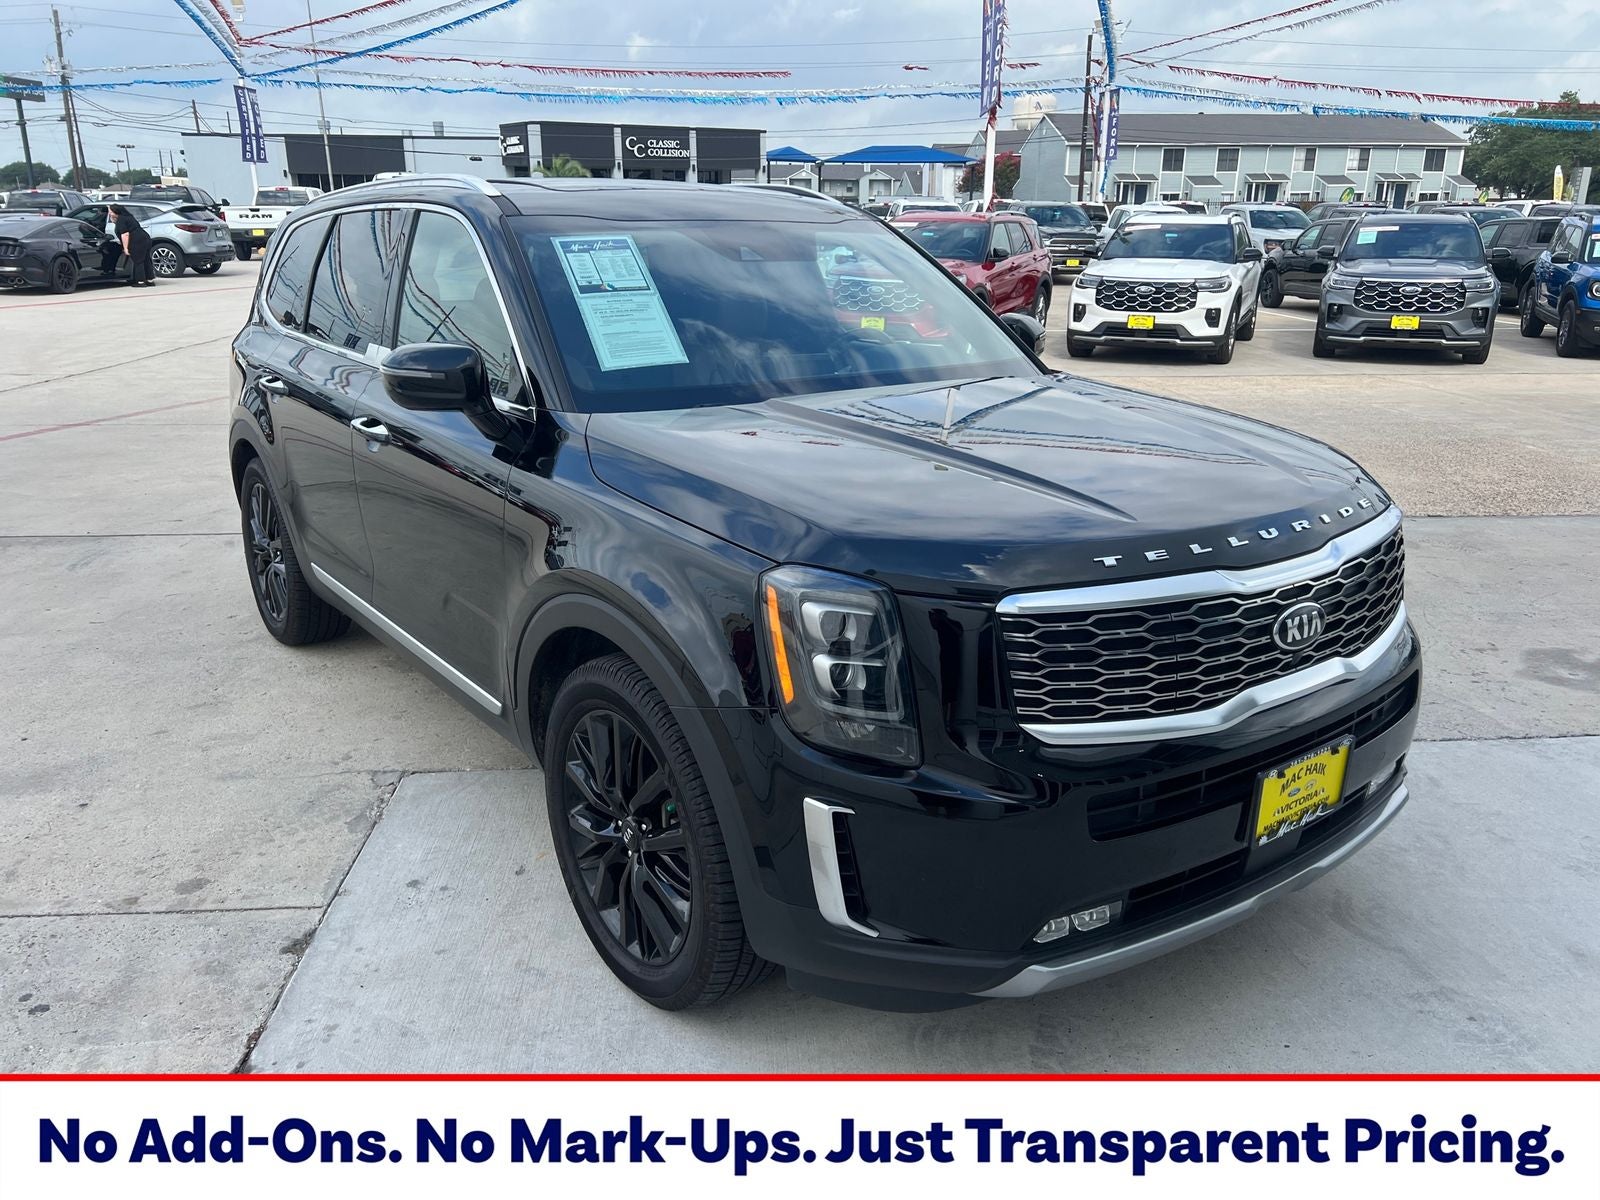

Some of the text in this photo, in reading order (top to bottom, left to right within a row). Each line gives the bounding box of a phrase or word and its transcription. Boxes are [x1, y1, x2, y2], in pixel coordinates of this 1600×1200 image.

[991, 23, 1003, 103] FORD
[238, 89, 252, 159] CERTIFIED
[1109, 117, 1117, 157] FORD
[647, 139, 680, 149] CLASSIC
[647, 148, 690, 158] COLLISION
[1093, 497, 1373, 569] TELLURIDE
[1285, 610, 1321, 642] KIA
[1280, 762, 1327, 796] MAC HAIK
